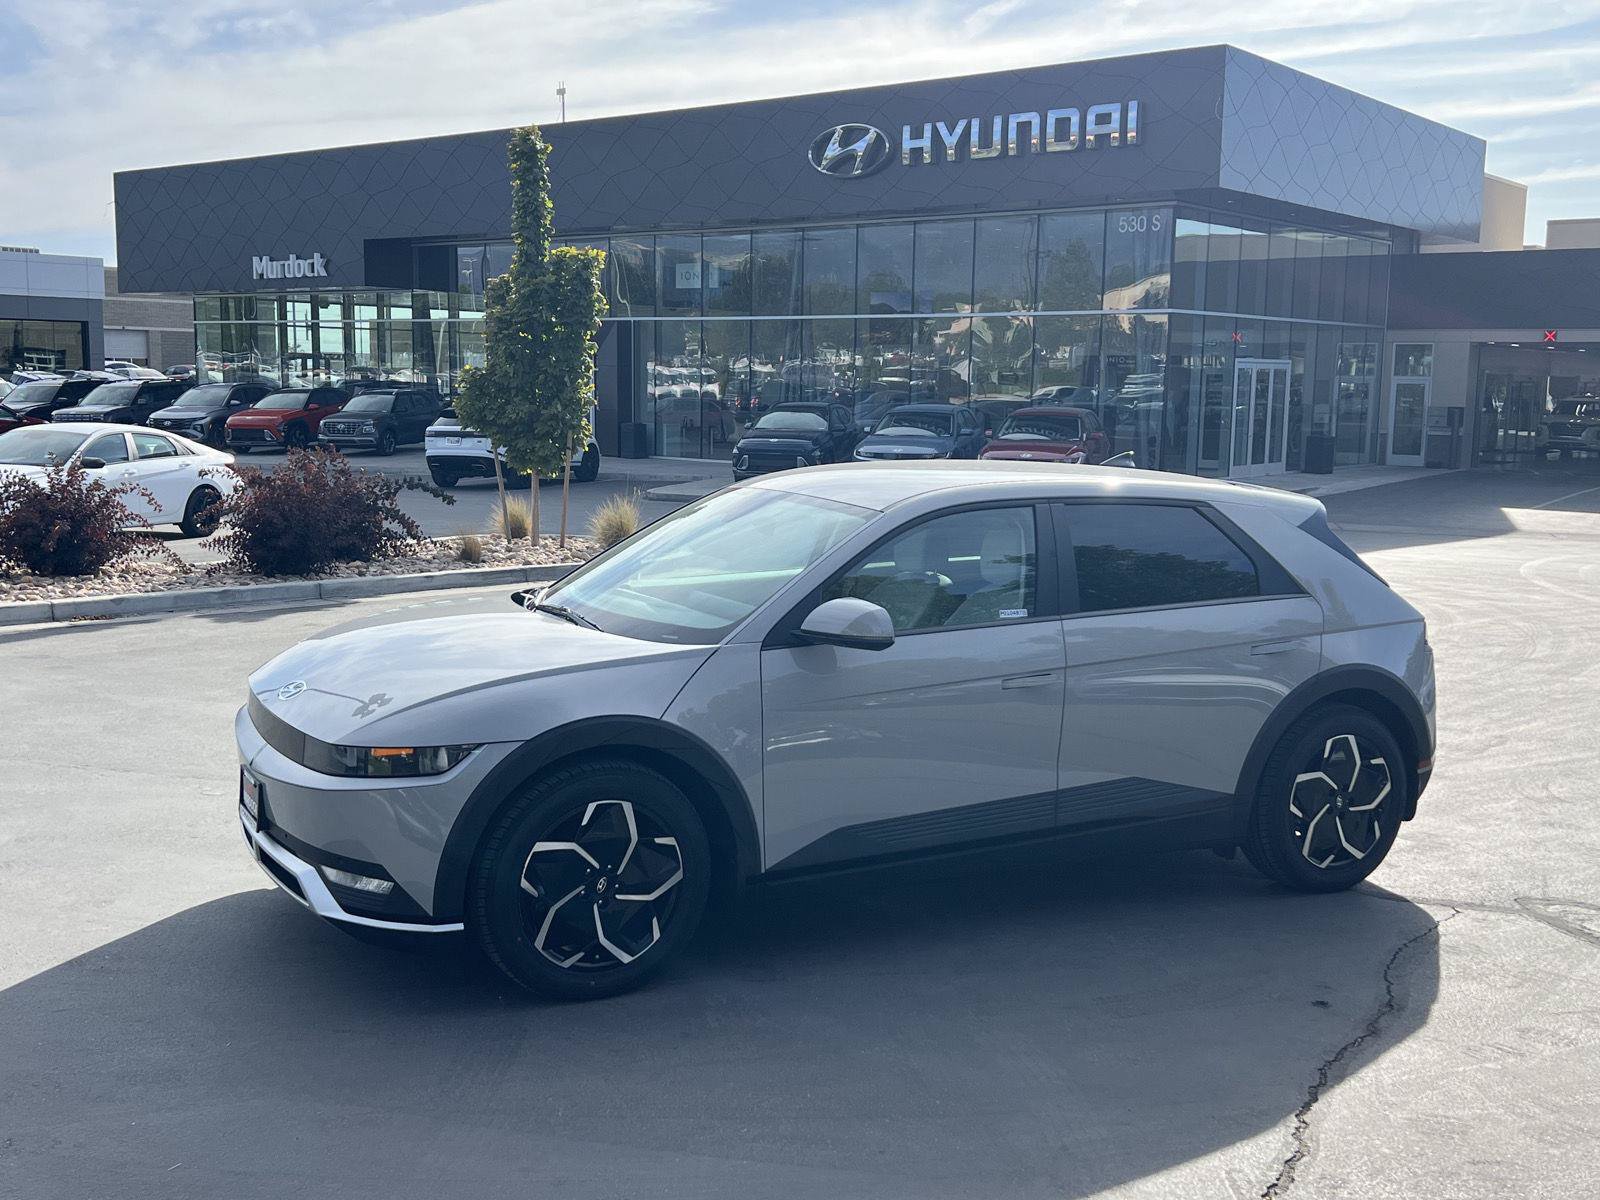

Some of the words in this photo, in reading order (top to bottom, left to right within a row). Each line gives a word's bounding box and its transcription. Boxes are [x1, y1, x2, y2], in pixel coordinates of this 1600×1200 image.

[902, 101, 1139, 165] HYUNDAI
[1119, 216, 1147, 232] 530
[1151, 215, 1161, 231] S
[252, 252, 327, 279] Murdock
